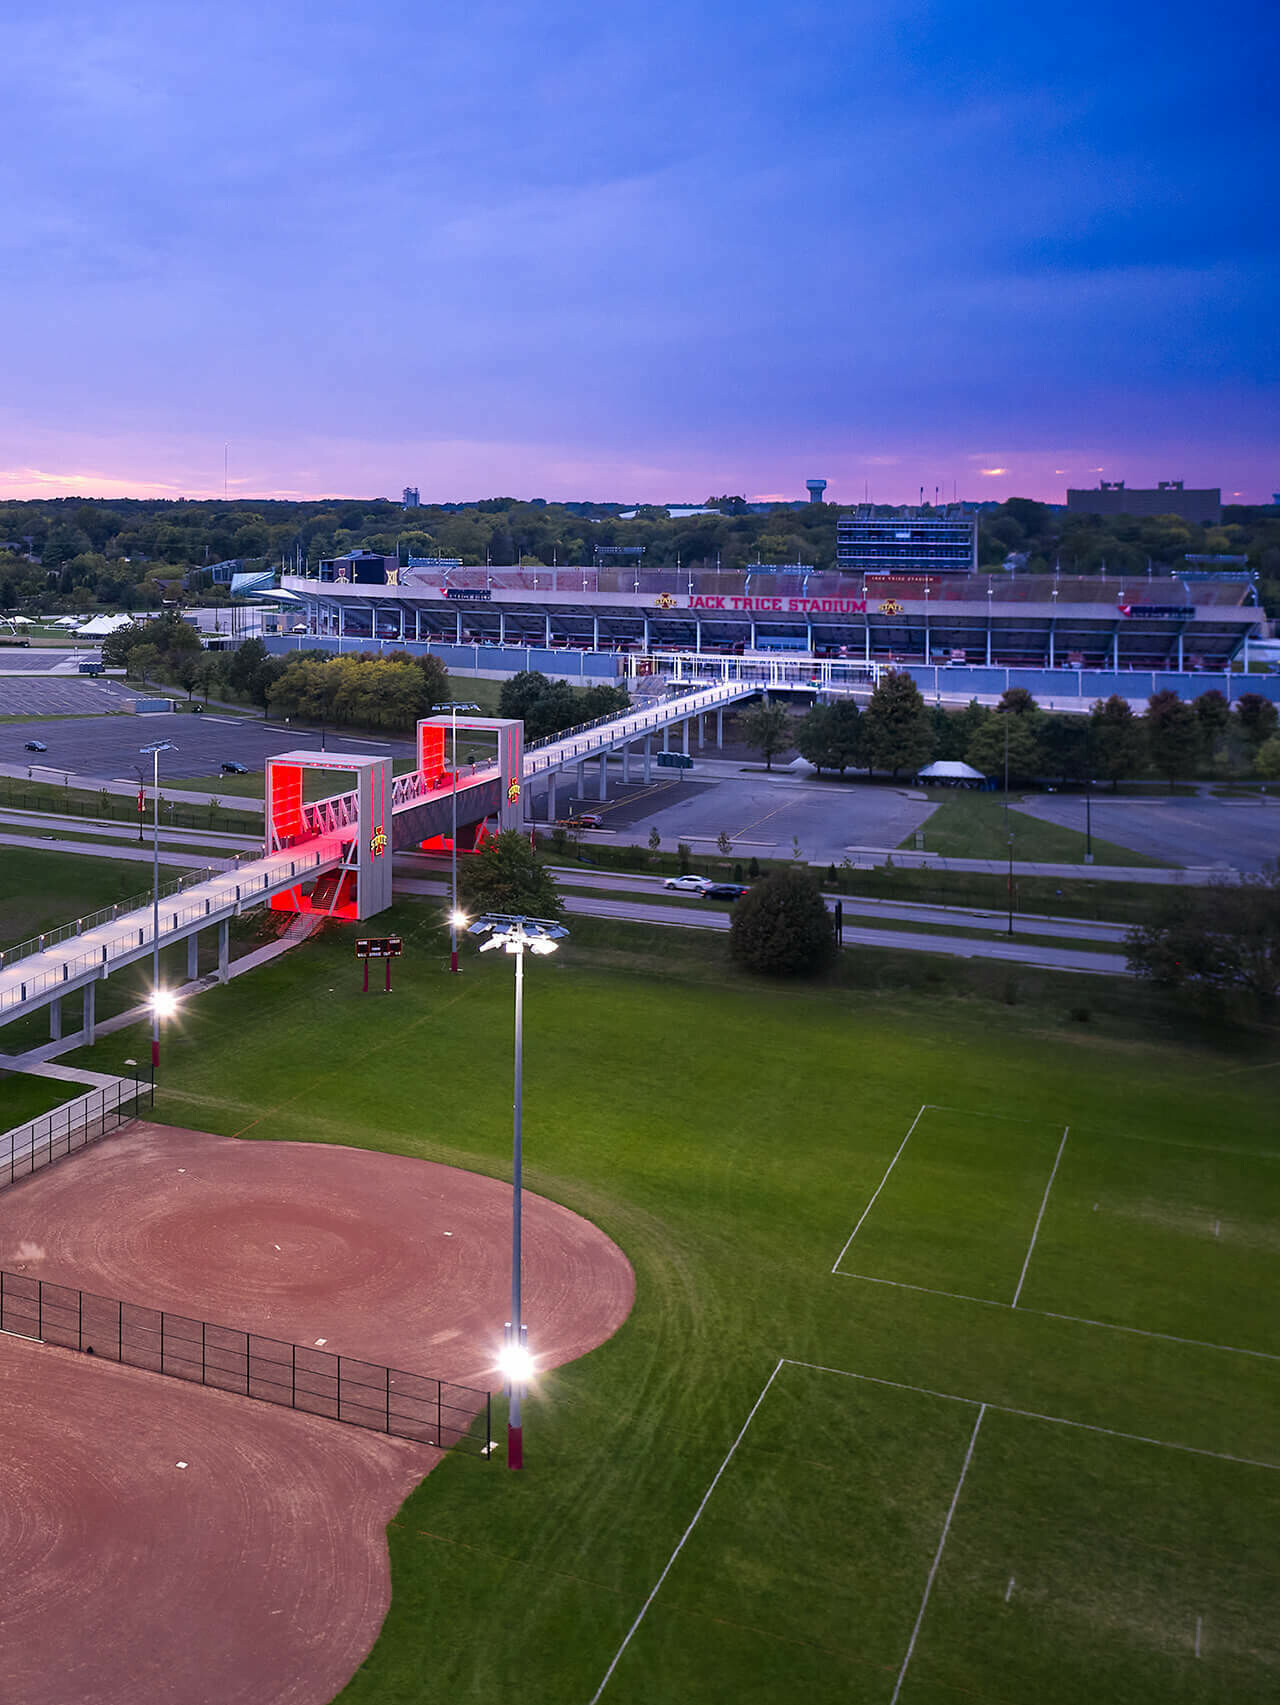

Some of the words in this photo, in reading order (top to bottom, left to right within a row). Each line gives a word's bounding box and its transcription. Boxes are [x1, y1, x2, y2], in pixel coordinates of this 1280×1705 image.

[688, 596, 725, 609] JACK
[730, 597, 782, 611] TRICE
[789, 599, 867, 613] STADIUM
